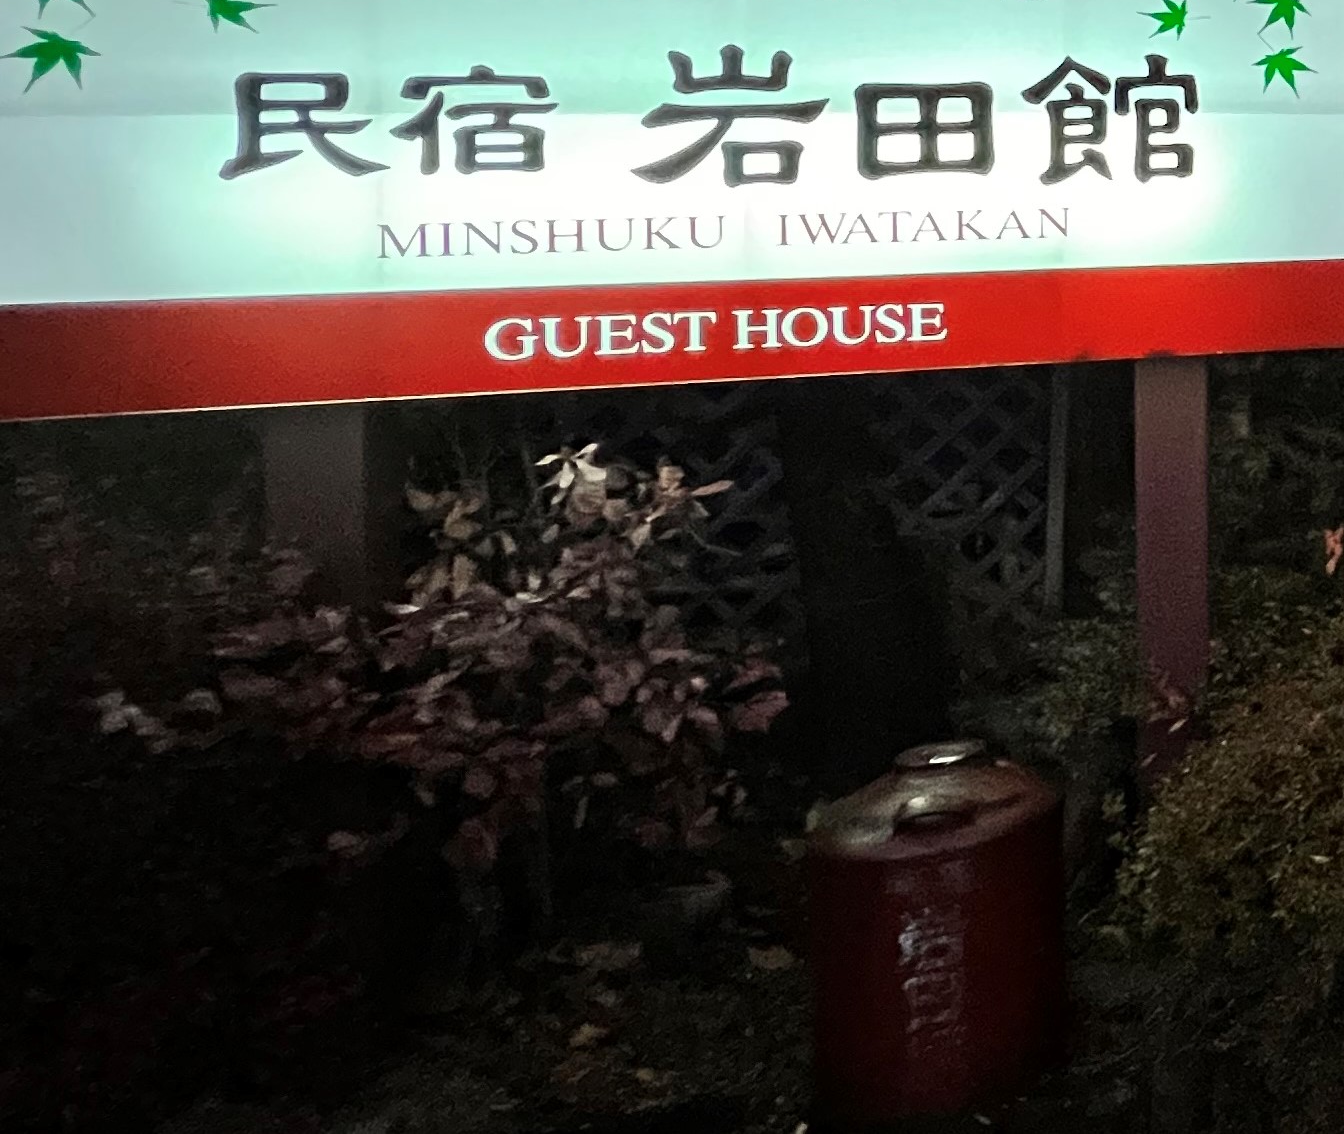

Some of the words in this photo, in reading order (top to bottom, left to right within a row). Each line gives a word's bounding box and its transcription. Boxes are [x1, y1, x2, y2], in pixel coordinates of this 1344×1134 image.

[219, 65, 558, 180] 民宿
[631, 44, 1199, 188] 岩田館
[376, 214, 726, 259] MINSHUKU
[777, 207, 1071, 247] IWATAKAN
[484, 311, 718, 362] GUEST
[732, 303, 948, 350] HOUSE
